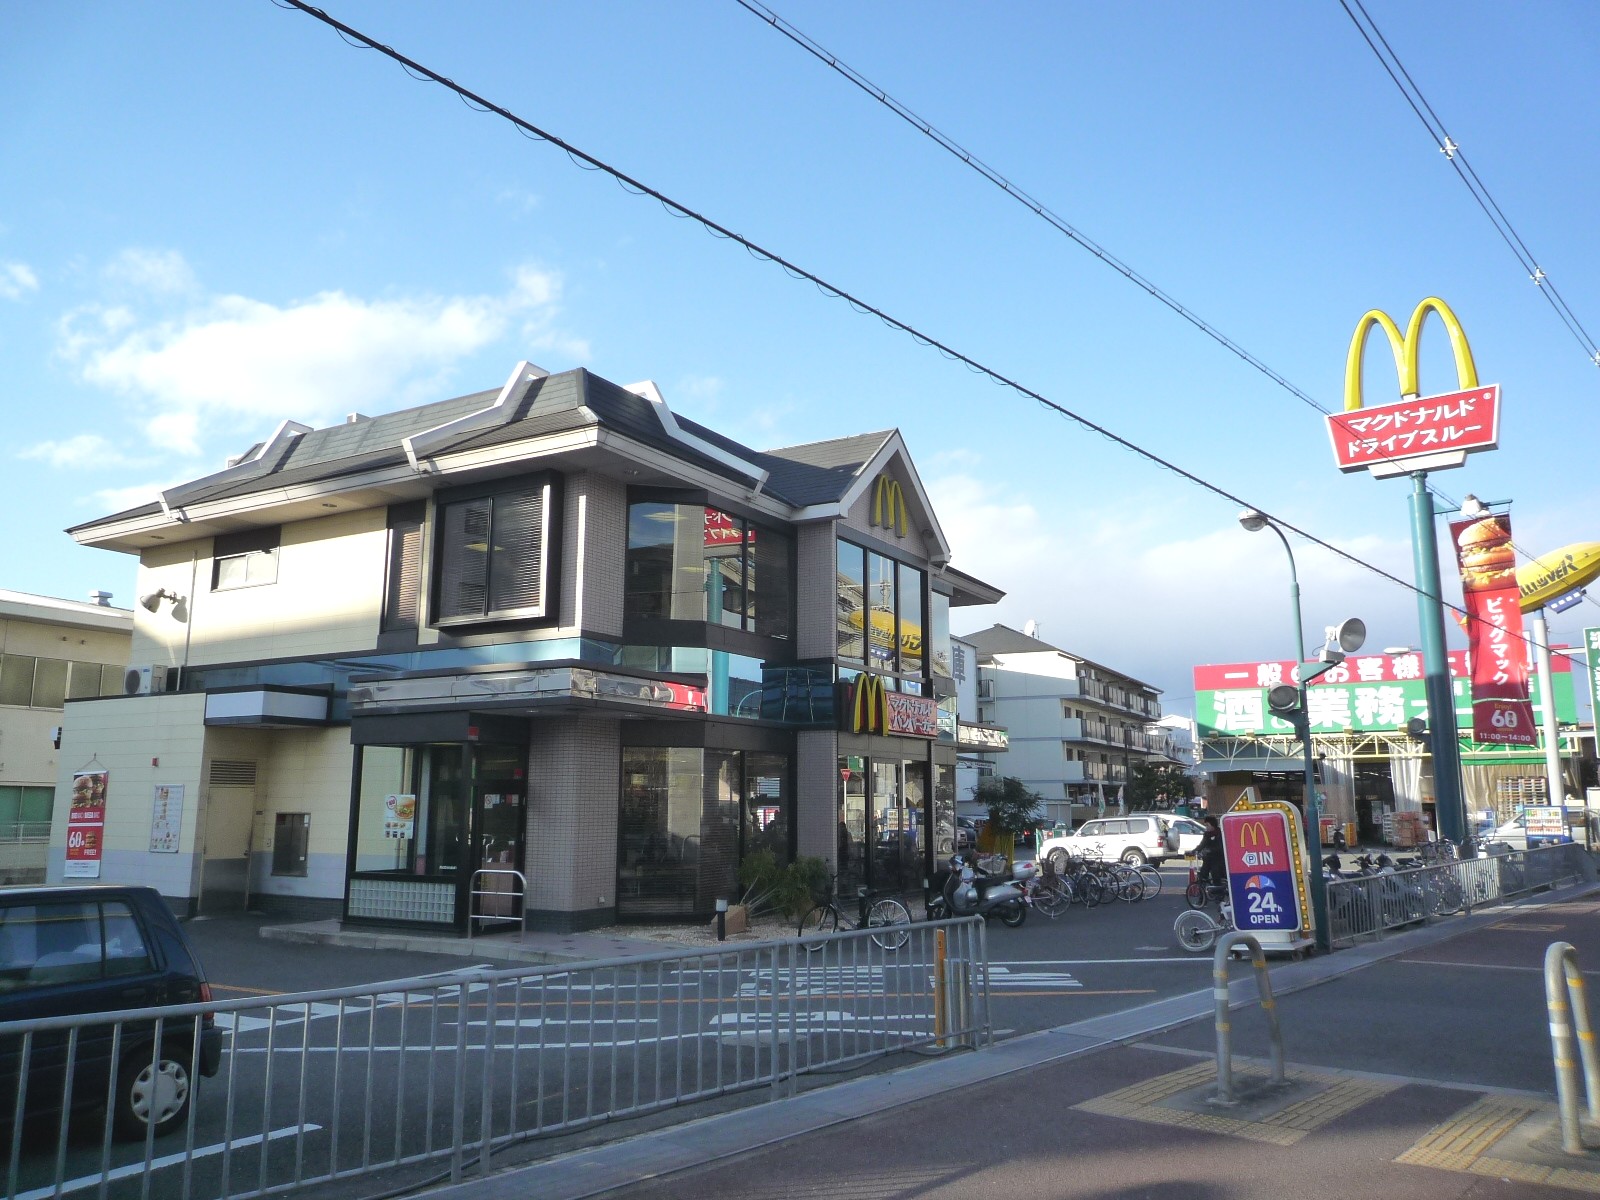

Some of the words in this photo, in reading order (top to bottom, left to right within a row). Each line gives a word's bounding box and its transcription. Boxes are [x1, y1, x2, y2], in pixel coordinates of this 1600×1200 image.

[1348, 398, 1476, 432] マクドナルド
[1348, 425, 1481, 457] ドライブスルー
[1486, 597, 1510, 685] ビッグマック
[1259, 851, 1274, 865] IN
[1250, 915, 1279, 924] OPEN
